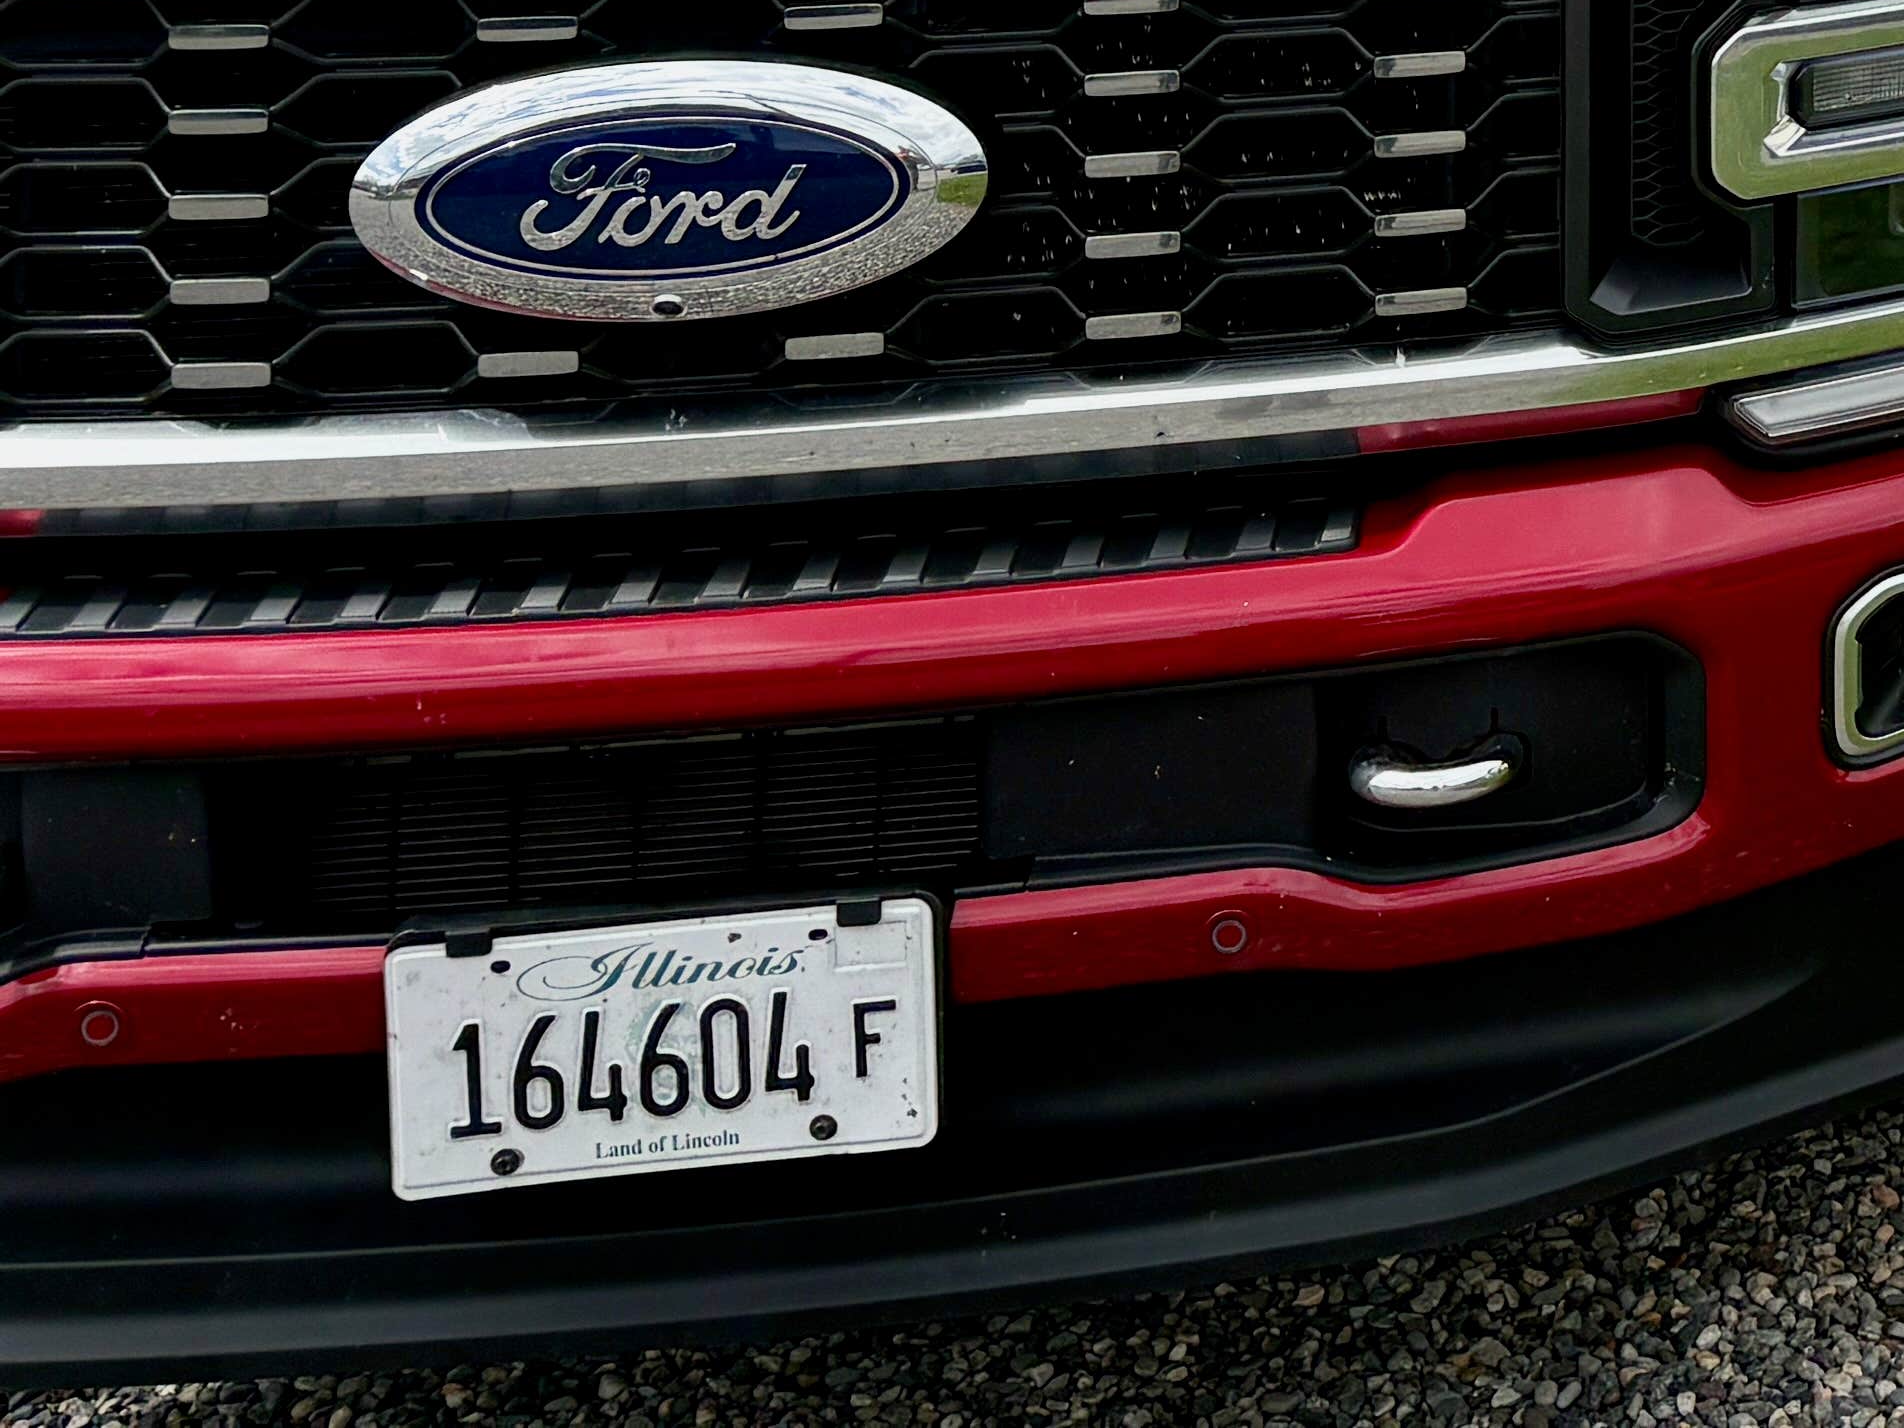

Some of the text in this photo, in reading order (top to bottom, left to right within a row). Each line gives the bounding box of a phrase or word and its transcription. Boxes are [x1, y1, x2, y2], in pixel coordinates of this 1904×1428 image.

[519, 142, 808, 252] Ford
[516, 942, 806, 1002] Illinois
[448, 989, 897, 1140] 164604 F
[595, 1129, 741, 1159] Land of Lincoln
